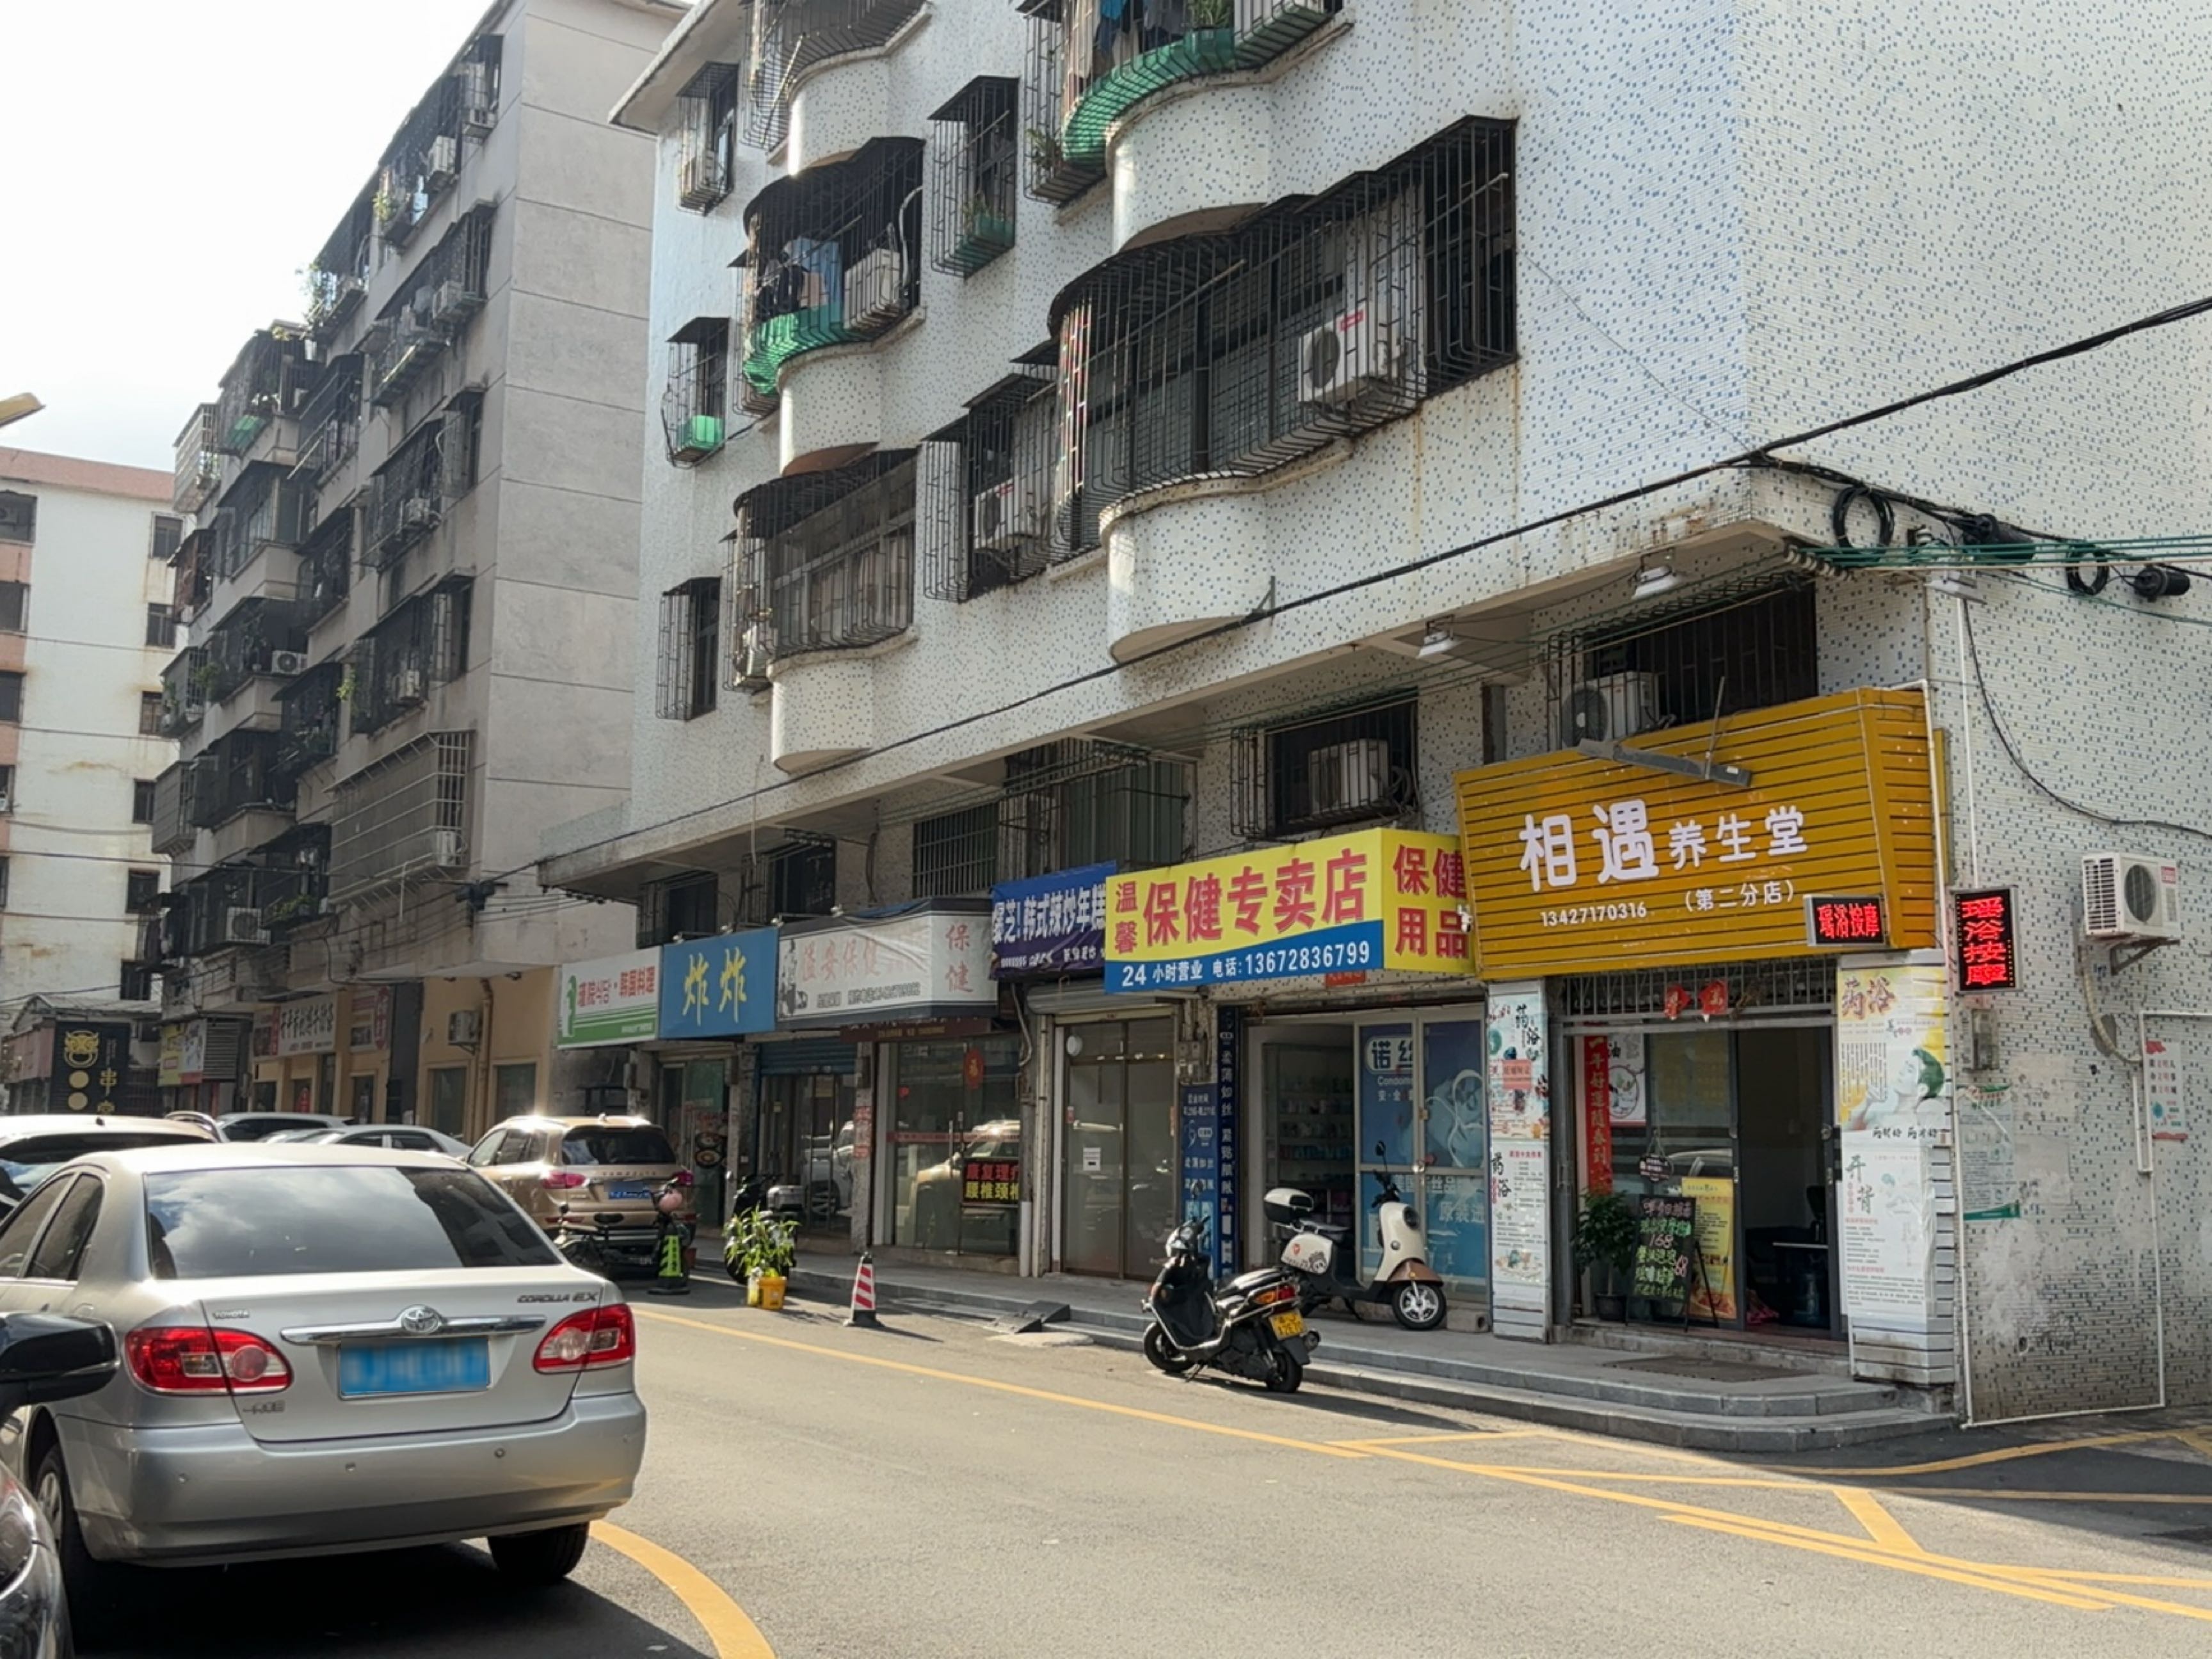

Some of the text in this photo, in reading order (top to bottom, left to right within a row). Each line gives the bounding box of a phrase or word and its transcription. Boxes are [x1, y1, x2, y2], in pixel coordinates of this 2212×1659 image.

[1393, 843, 1465, 900] 保健
[1520, 798, 1808, 892] 相遇养生堂
[1115, 881, 1138, 954] 温馨
[1142, 847, 1368, 947] 保健专卖店
[1396, 906, 1470, 959] 用品
[1540, 902, 1647, 927] 13427170316
[944, 922, 974, 993] 保健
[1121, 963, 1147, 988] 24
[1153, 960, 1203, 984] 小时营业
[1246, 940, 1370, 976] 13672836799
[1960, 895, 2008, 986] 瑶浴按摩
[682, 946, 748, 1027] 炸炸
[572, 1292, 599, 1302] EX
